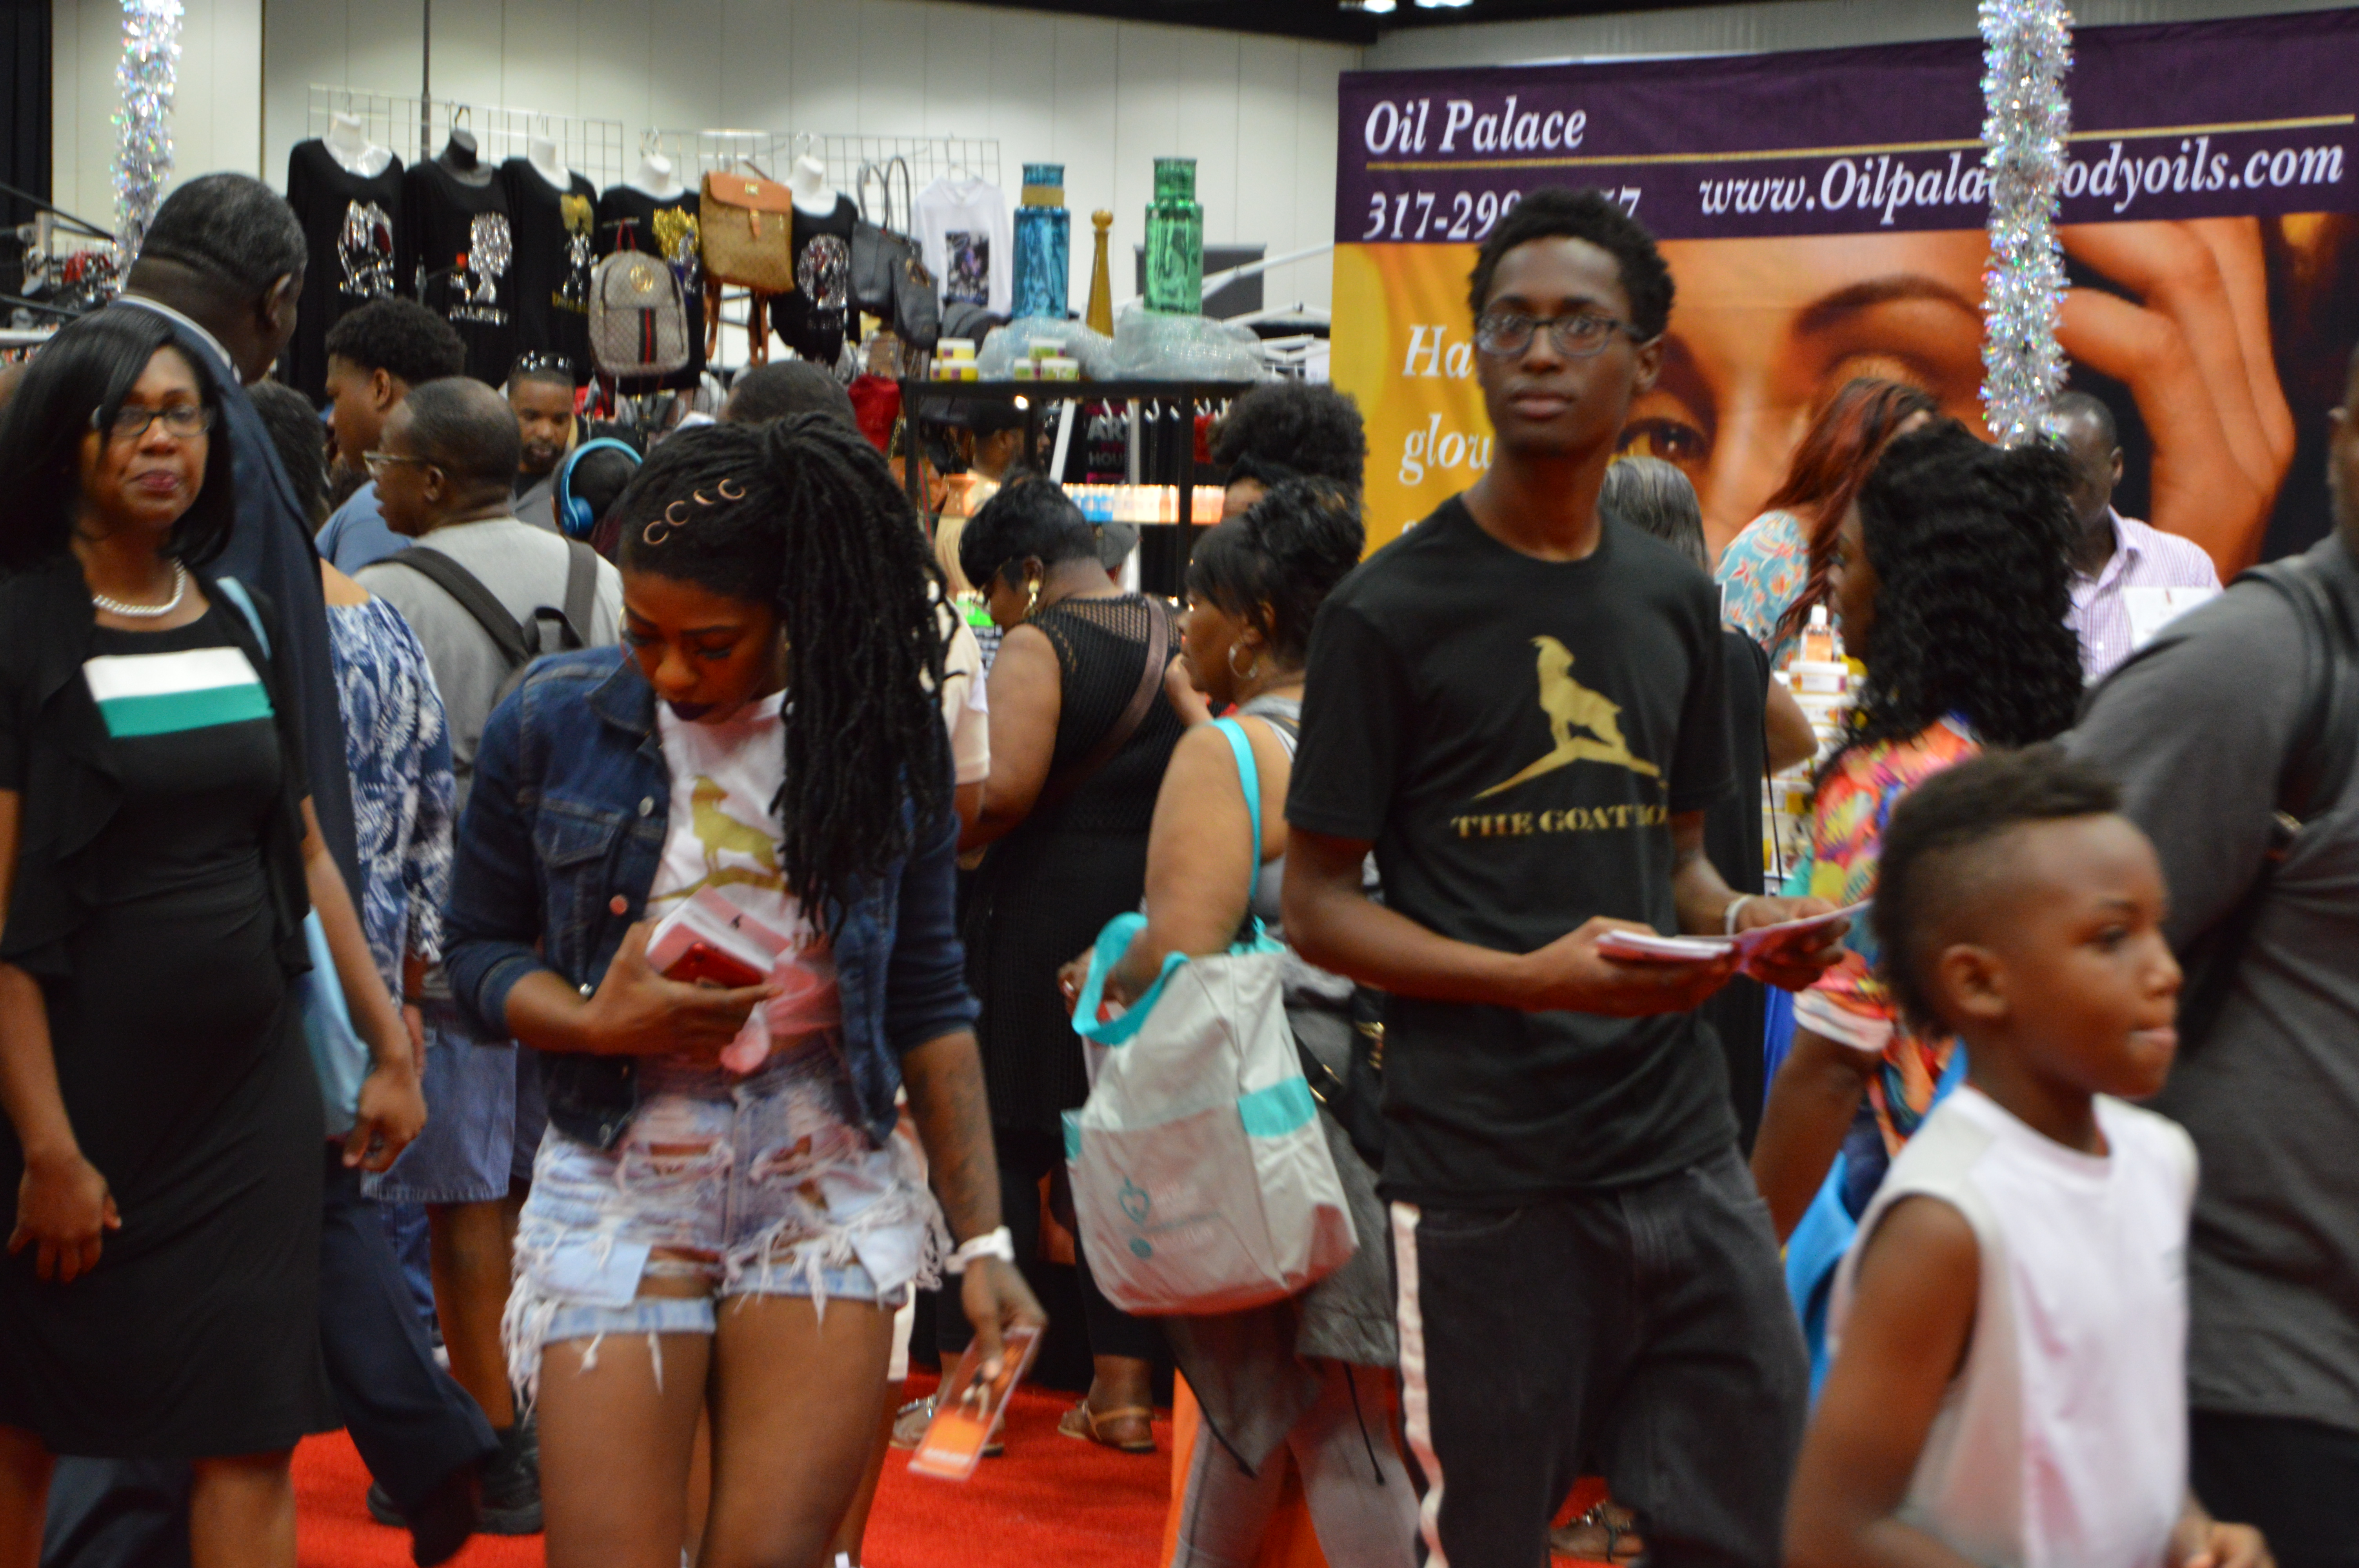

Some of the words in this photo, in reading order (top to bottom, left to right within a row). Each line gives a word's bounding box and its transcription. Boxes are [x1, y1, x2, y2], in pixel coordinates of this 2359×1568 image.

[1364, 98, 1430, 154] Oil
[1439, 95, 1587, 152] Palace
[1450, 812, 1534, 838] THE
